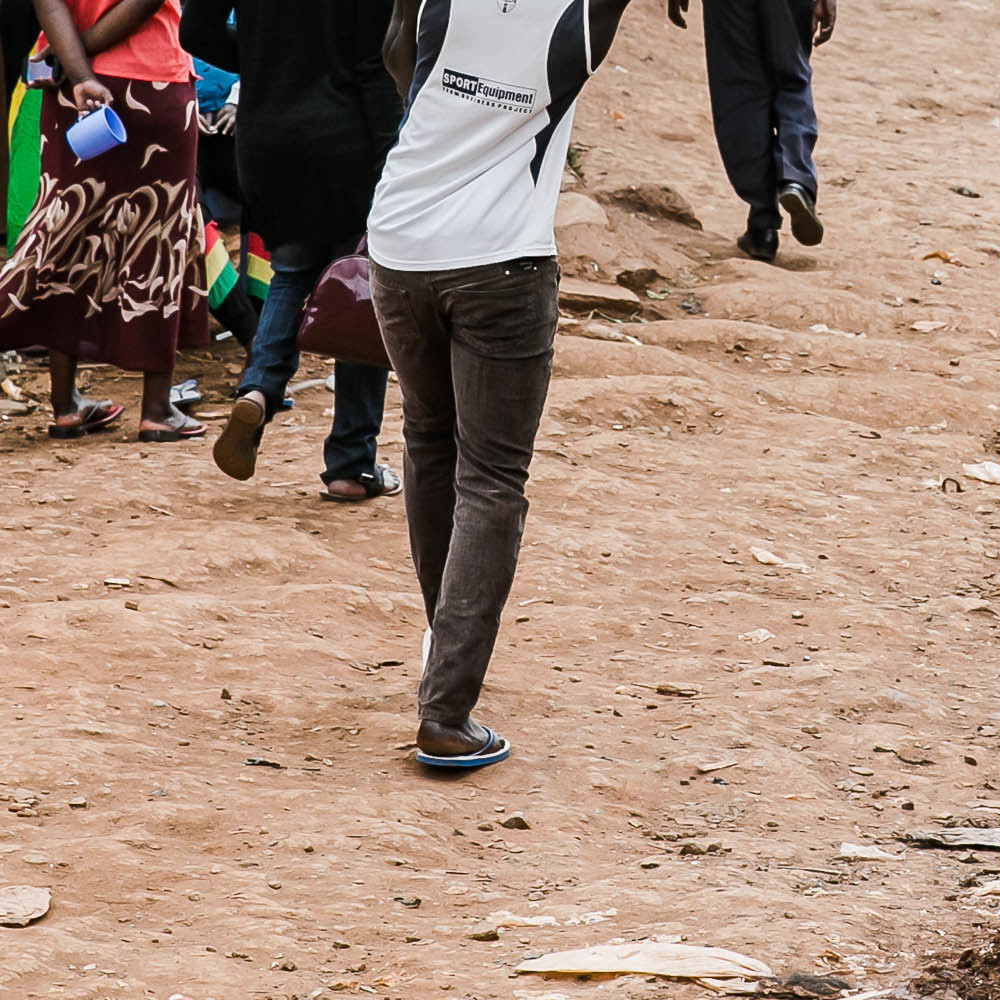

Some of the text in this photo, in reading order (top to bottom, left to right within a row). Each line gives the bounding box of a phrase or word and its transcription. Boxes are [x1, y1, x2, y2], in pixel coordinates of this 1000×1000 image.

[442, 86, 533, 115] TEAM BUSINESS PROJECT
[443, 72, 534, 105] SPORT Equipment
